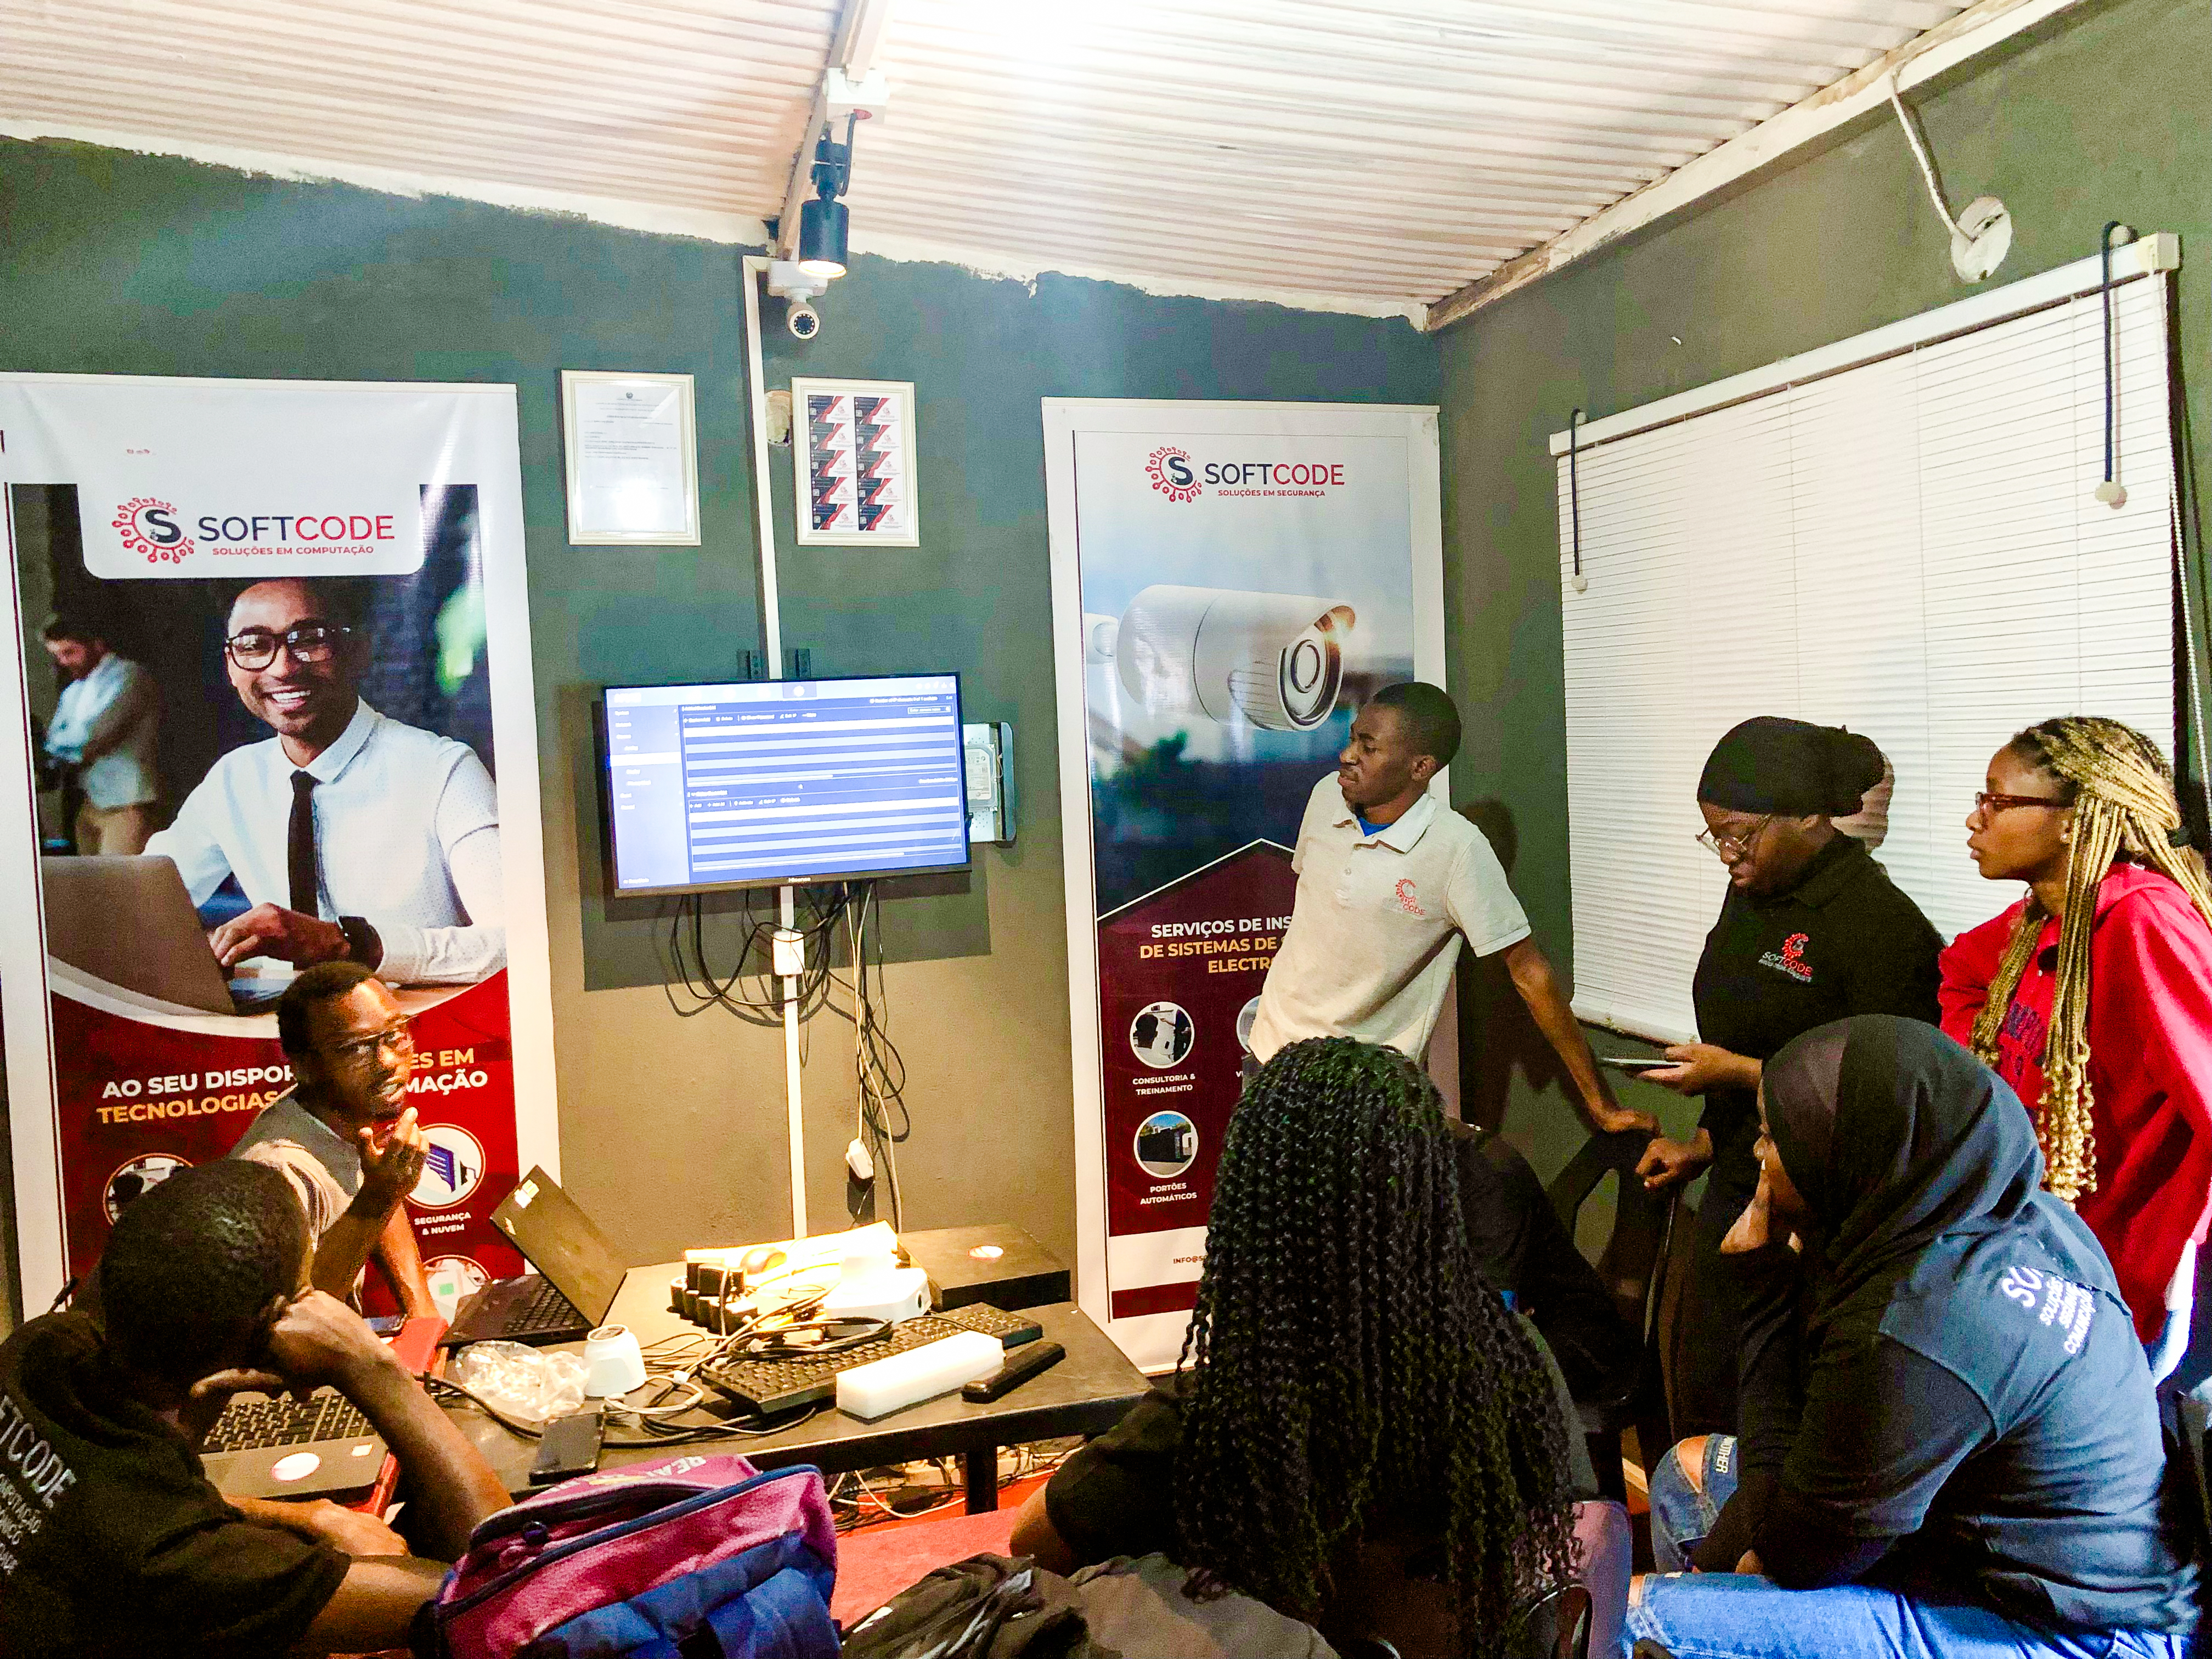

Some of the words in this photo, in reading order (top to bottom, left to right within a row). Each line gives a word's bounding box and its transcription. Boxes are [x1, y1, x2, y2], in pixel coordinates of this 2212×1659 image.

[1205, 463, 1345, 485] SOFTCODE
[1217, 488, 1261, 498] SOLUÇÕES
[1277, 489, 1325, 498] SEGURANÇA
[198, 516, 395, 541] SOFTCODE
[212, 545, 273, 556] SOLUÇÕES
[276, 547, 292, 555] EM
[296, 545, 374, 556] COMPUTAÇÃO
[1151, 919, 1235, 938] SERVIÇOS
[1239, 918, 1262, 932] DE
[1140, 944, 1164, 959] DE
[1168, 938, 1252, 957] SISTEMAS
[1255, 936, 1278, 951] DE
[1208, 956, 1273, 973] ELECTR
[1762, 951, 1813, 977] SOFTCODE
[439, 1048, 475, 1067] EM
[101, 1079, 142, 1099] AO
[148, 1073, 198, 1095] SEU
[1132, 1074, 1188, 1085] CONSULTORIA
[1135, 1084, 1193, 1096] TREINAMENTO
[96, 1091, 279, 1124] TECNOLOGIAS
[1150, 1182, 1187, 1193] PORTÕES
[1140, 1192, 1198, 1205] AUTOMÁTICOS
[414, 1211, 472, 1226] SEGURANÇA
[431, 1223, 465, 1234] NUVEM
